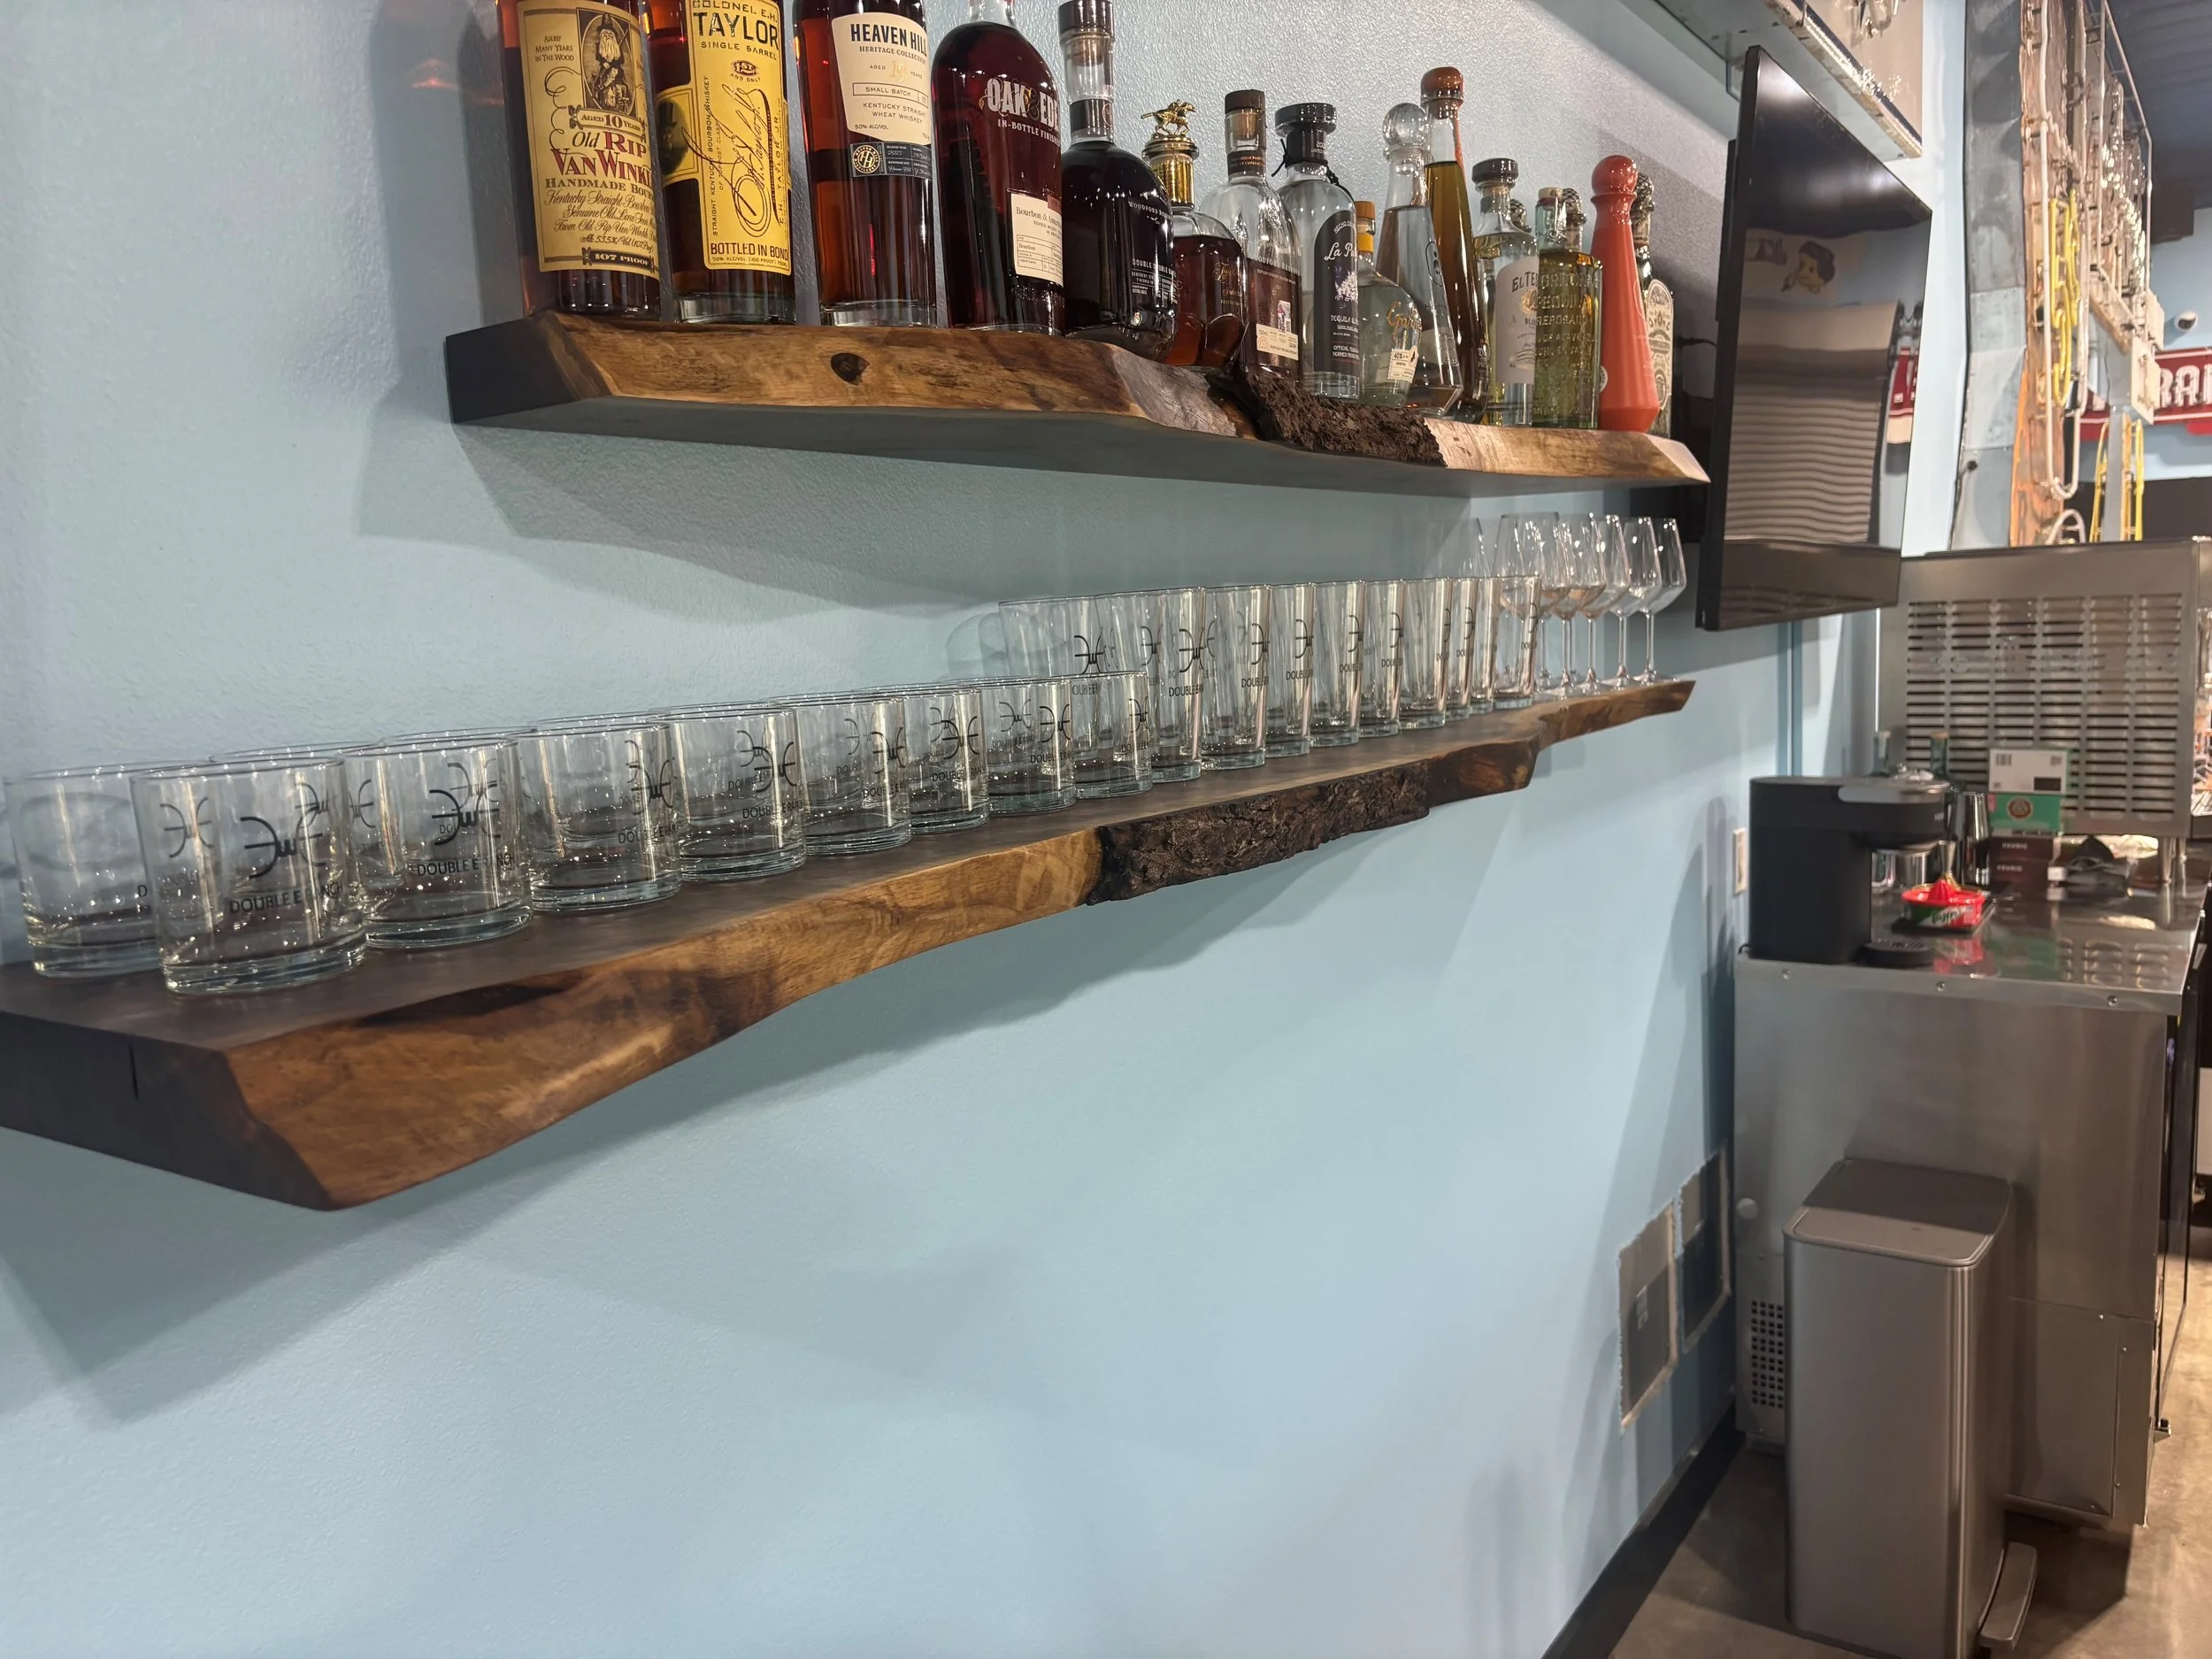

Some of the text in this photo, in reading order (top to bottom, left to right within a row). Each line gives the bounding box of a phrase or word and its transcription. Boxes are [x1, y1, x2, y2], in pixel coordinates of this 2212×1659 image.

[693, 12, 780, 50] TAYLOR
[850, 23, 927, 58] HEAVEN HILL
[701, 41, 778, 61] SINGLE BARREL
[859, 45, 895, 55] HERITAGE
[891, 88, 912, 97] BATCH
[987, 78, 1028, 118] OAK
[1040, 91, 1059, 133] EDE
[604, 113, 623, 129] 10
[898, 113, 923, 124] WHISKEY
[997, 119, 1040, 136] IN-BOTTLE
[572, 131, 648, 157] Old RIP
[550, 148, 652, 188] VAN WINKL
[545, 177, 626, 191] HANDMADE
[544, 188, 588, 210] Kentucky
[588, 190, 623, 207] Straight
[1016, 206, 1042, 220] Bourbon
[710, 242, 789, 261] BOTTLED IN BOND
[1324, 242, 1342, 261] La
[417, 860, 472, 876] DOUBLE
[228, 891, 292, 915] DOUBLE
